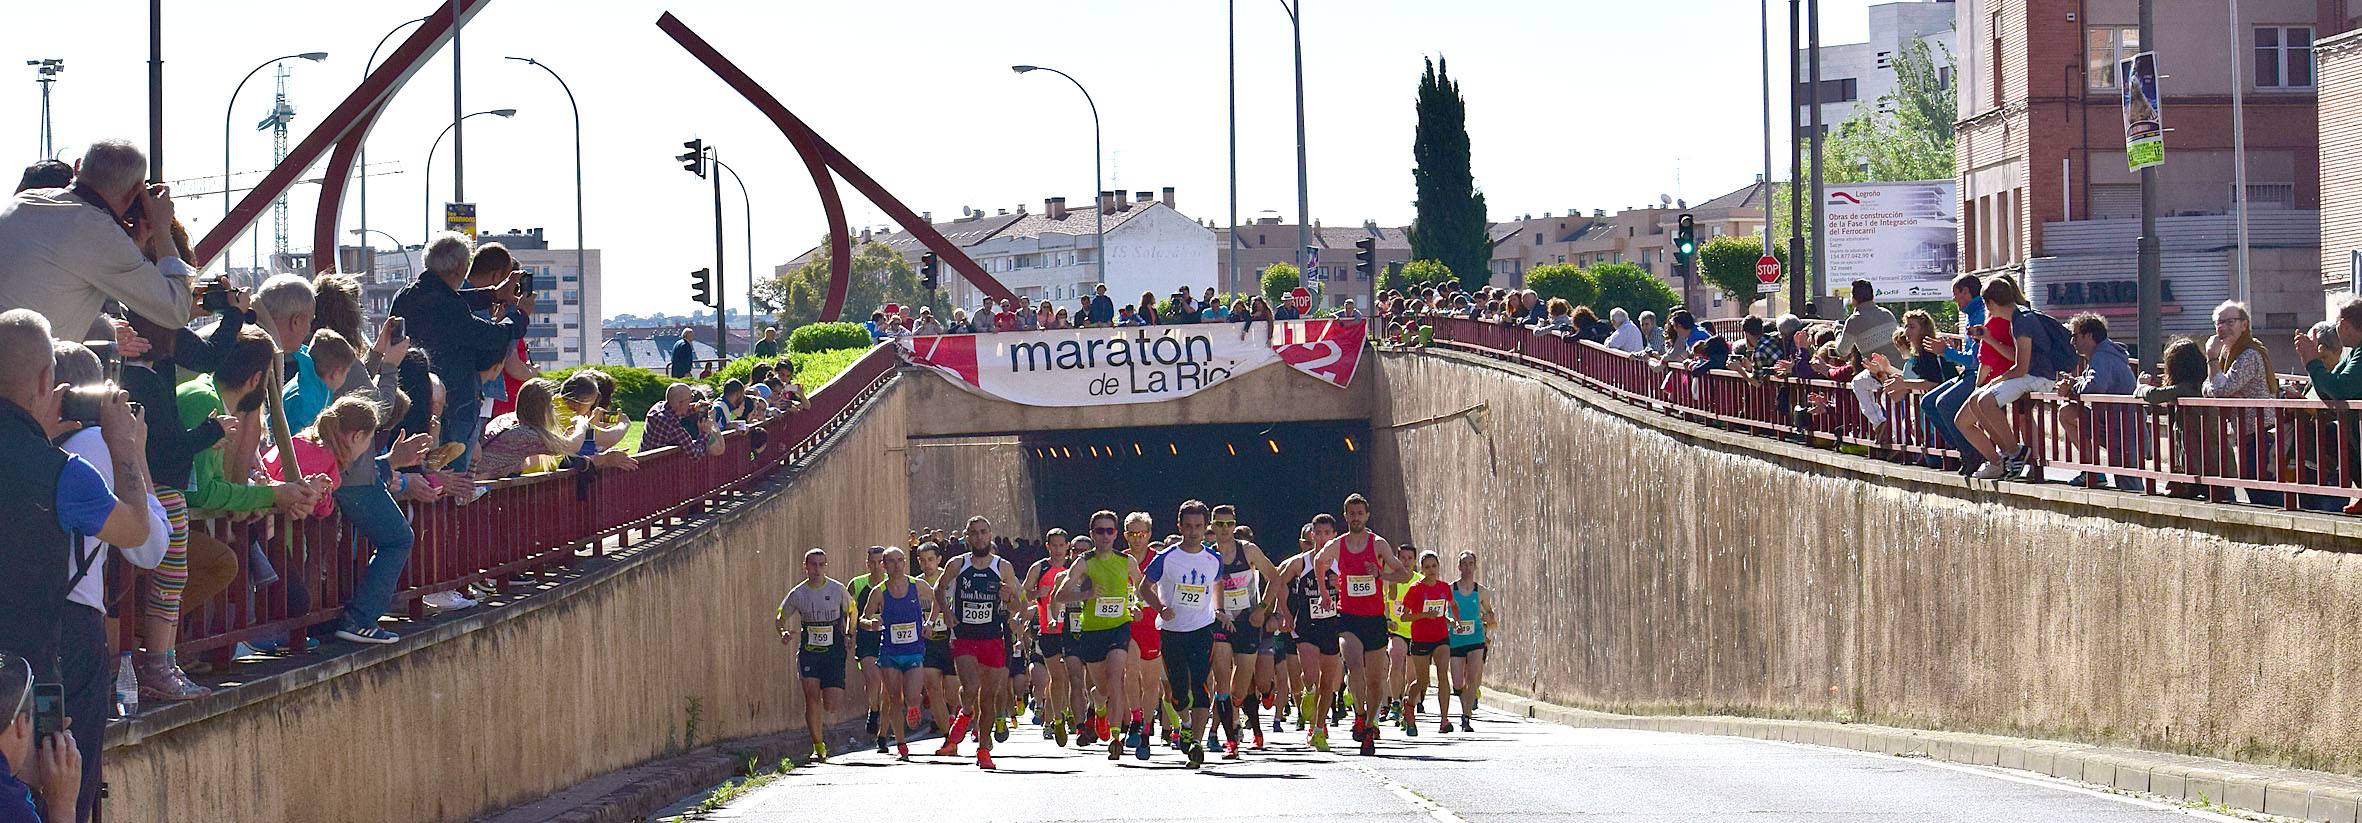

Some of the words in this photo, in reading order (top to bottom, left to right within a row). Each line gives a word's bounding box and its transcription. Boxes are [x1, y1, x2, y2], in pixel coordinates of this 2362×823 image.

[1855, 190, 1880, 198] Logroño
[1860, 211, 1903, 219] construcción
[1839, 220, 1846, 228] la
[1847, 220, 1863, 228] Fase
[1869, 219, 1878, 227] de
[1880, 218, 1918, 227] Integración
[1841, 227, 1876, 235] Ferrocarril
[1757, 264, 1779, 275] STOP
[2046, 282, 2085, 305] LA
[1010, 328, 1212, 373] maratón
[1088, 372, 1119, 396] de
[1130, 361, 1168, 394] La
[1352, 583, 1371, 592] 856
[1181, 592, 1200, 603] 792
[1101, 604, 1119, 613] 852
[965, 610, 990, 620] 2089
[813, 633, 828, 642] 759
[896, 630, 912, 639] 972
